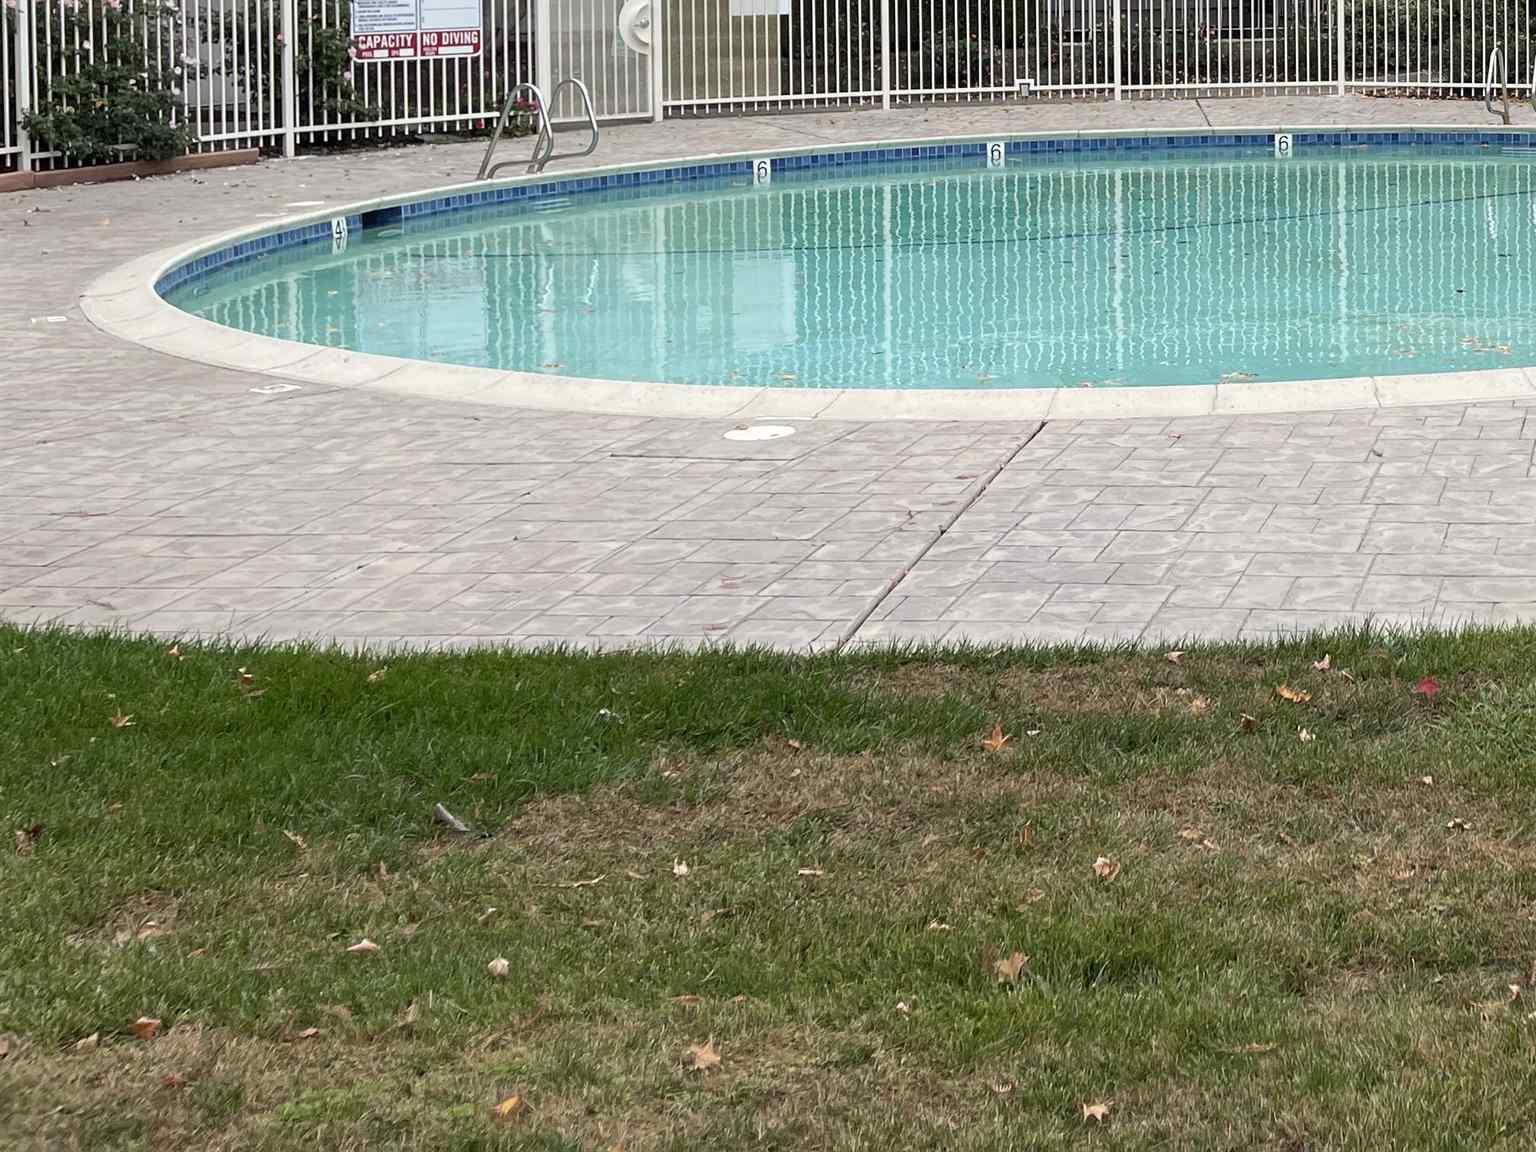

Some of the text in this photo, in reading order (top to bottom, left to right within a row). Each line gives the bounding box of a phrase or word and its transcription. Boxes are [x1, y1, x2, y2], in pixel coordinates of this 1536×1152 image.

[358, 34, 413, 49] CAPACITY
[422, 31, 479, 46] NO DIVING
[991, 143, 1001, 162] 6
[1278, 135, 1289, 153] 6
[757, 160, 768, 178] 6
